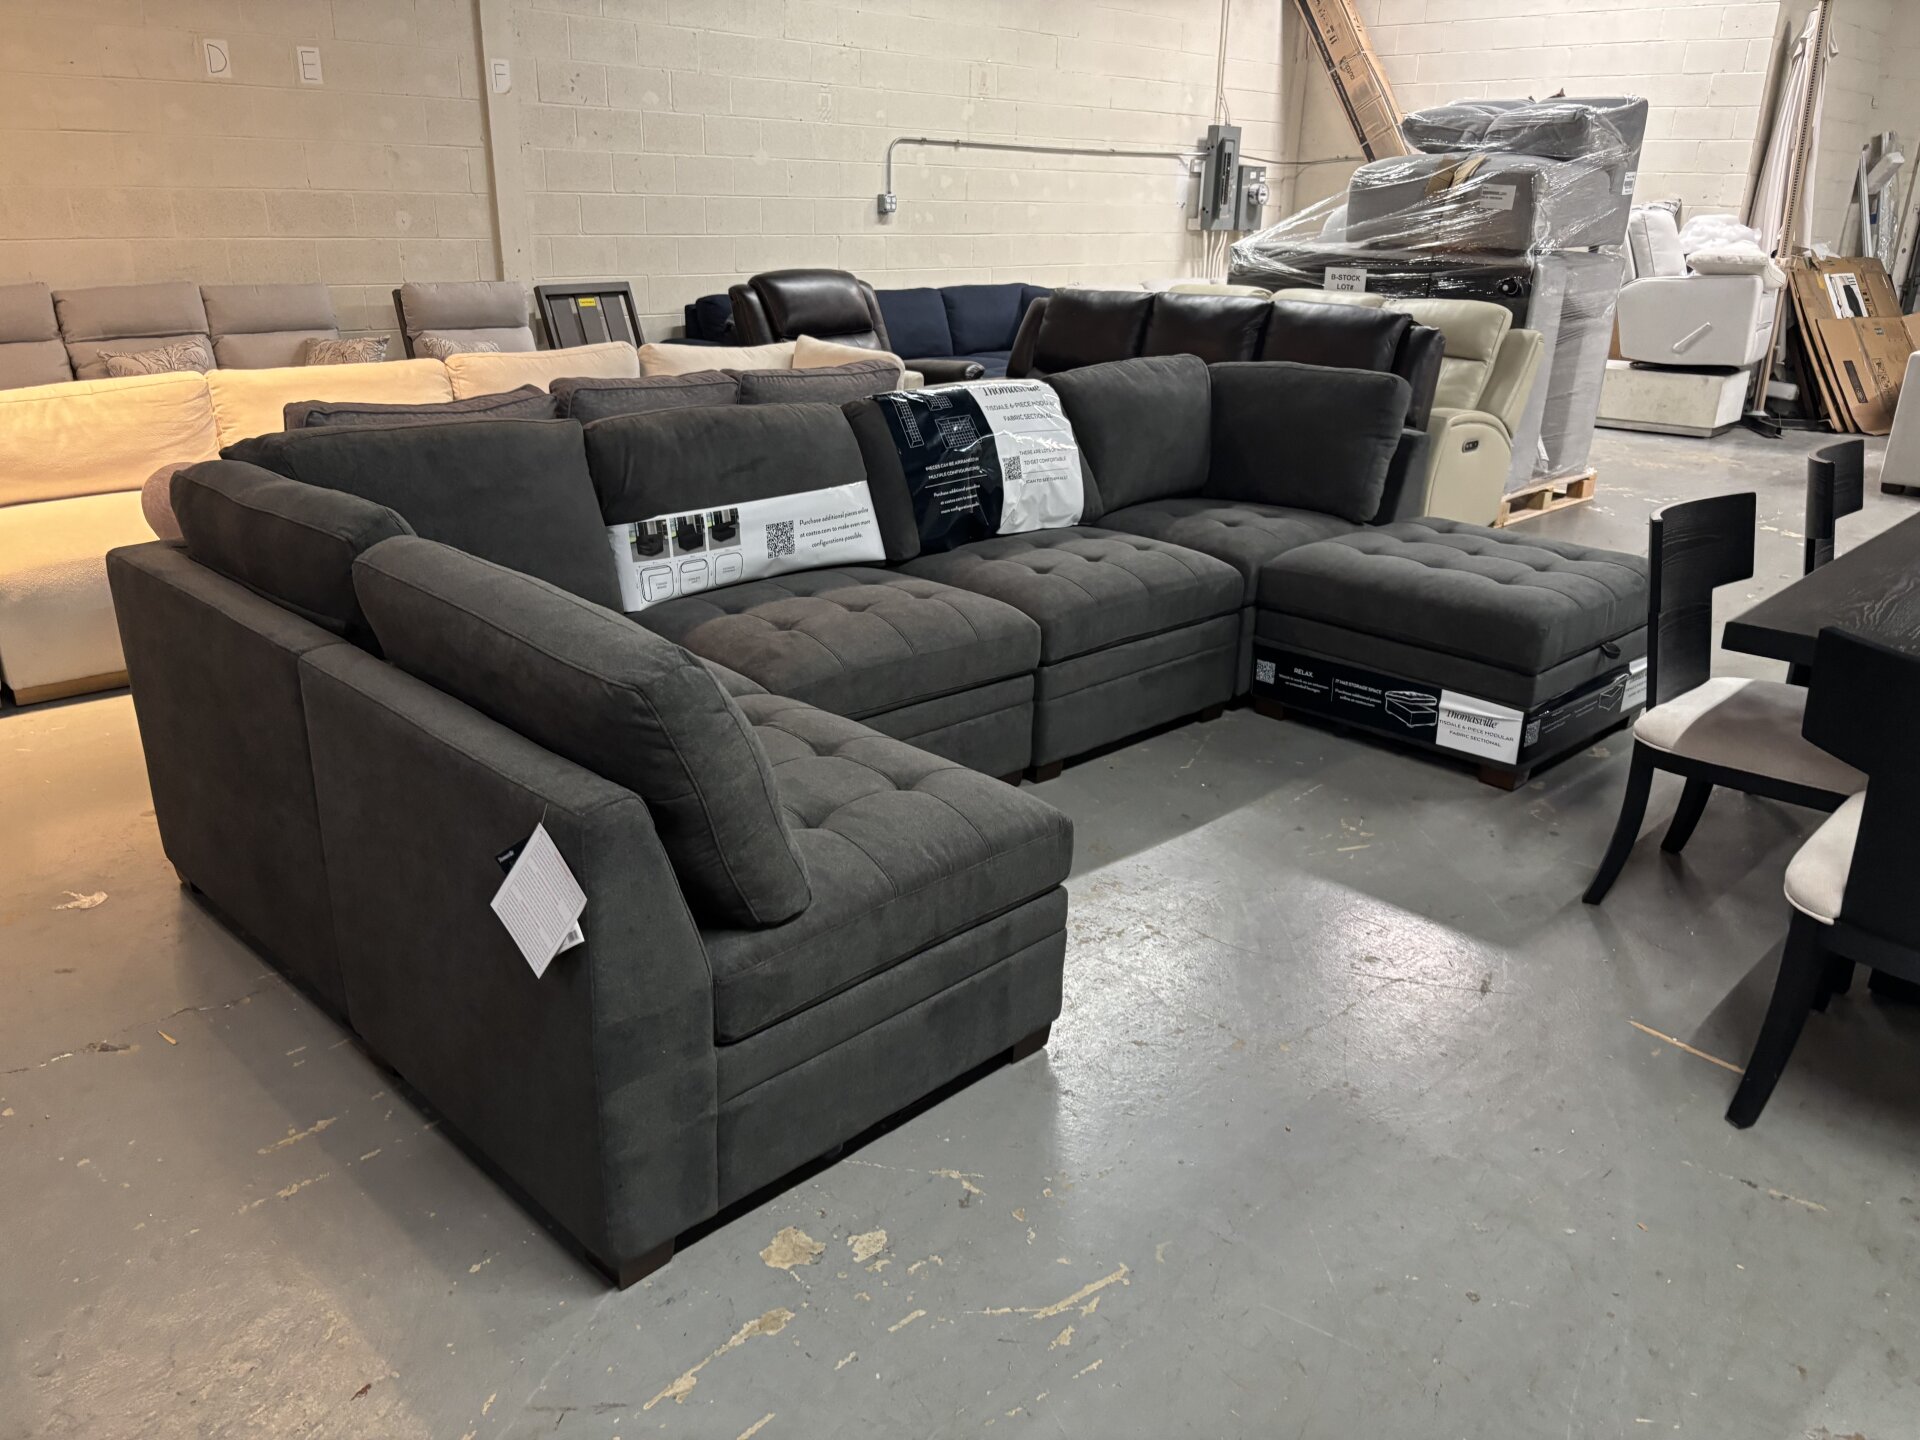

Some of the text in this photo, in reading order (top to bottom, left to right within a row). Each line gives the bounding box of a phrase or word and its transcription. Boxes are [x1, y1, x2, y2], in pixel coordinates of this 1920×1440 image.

[206, 43, 228, 74] D
[300, 50, 318, 81] E
[493, 63, 507, 88] F
[800, 517, 821, 526] Purchase
[822, 511, 844, 522] additional
[812, 538, 844, 548] configurations
[1293, 667, 1314, 678] RELAX
[1368, 686, 1382, 695] SPACE
[1446, 709, 1498, 729] Thomasville
[1440, 719, 1461, 729] TISDALE
[1485, 731, 1514, 741] MODULAR
[1449, 730, 1501, 747] FABRIC SECTIONAL
